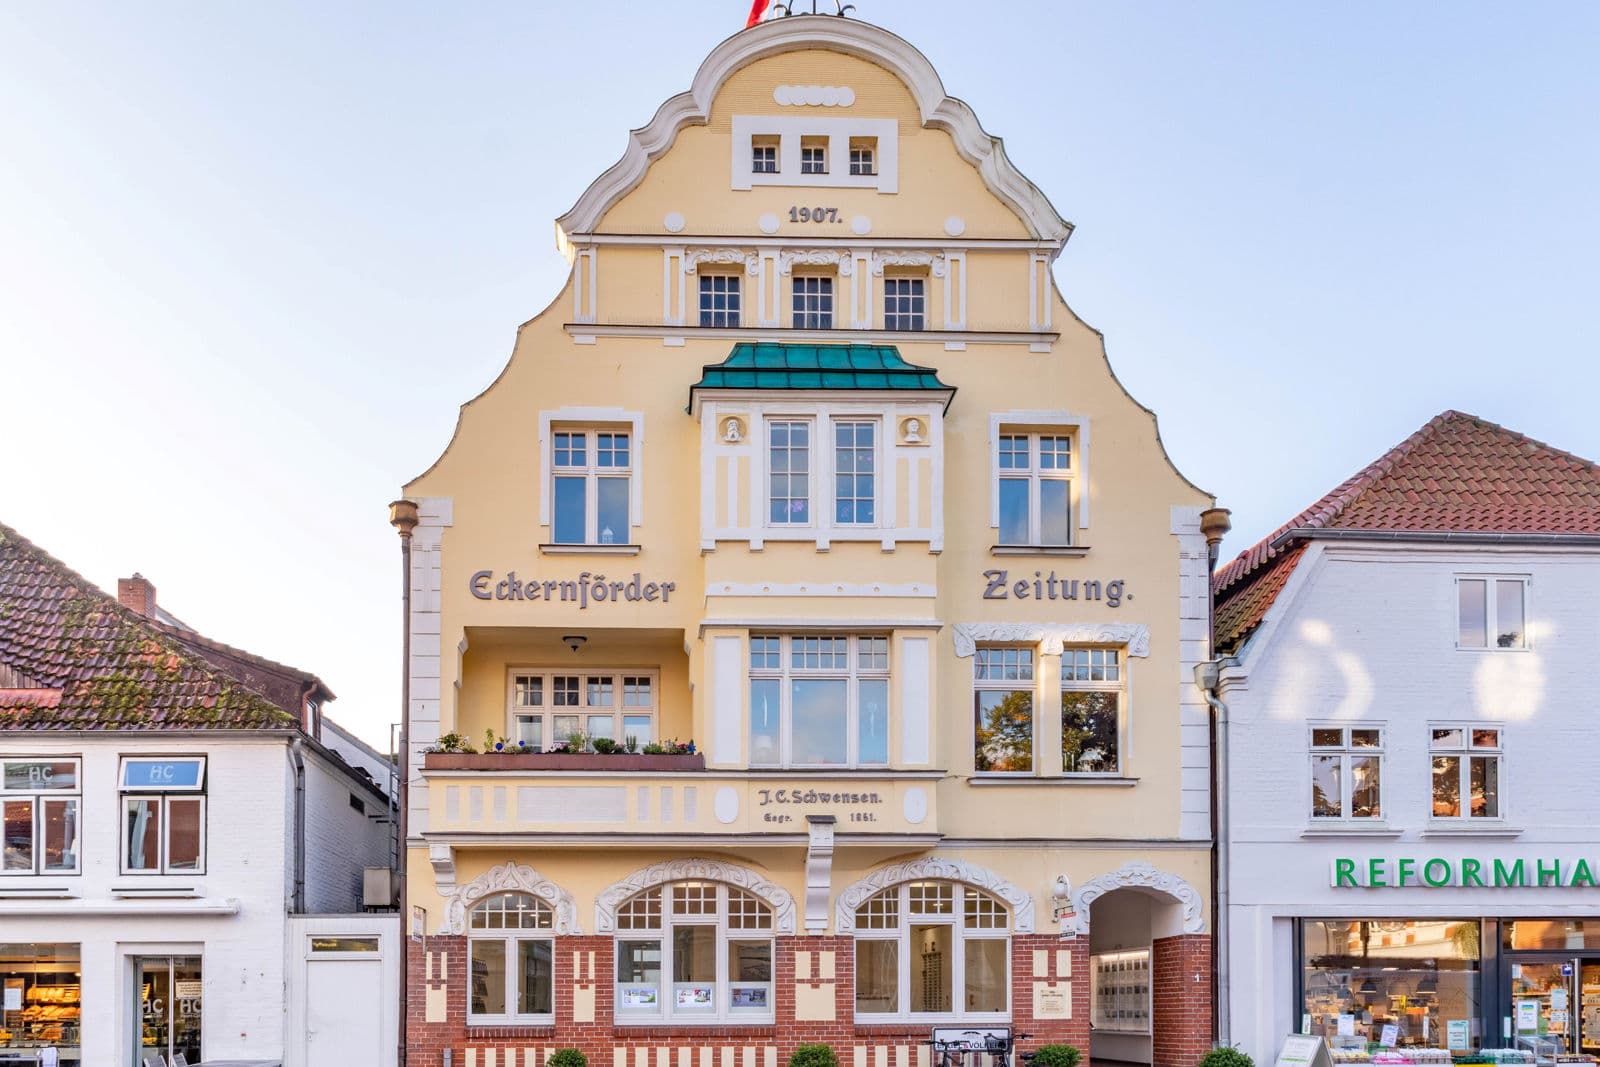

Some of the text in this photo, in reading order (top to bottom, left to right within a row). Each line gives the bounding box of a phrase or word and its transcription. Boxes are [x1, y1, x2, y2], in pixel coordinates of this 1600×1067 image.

[789, 206, 843, 223] 1907.
[469, 570, 676, 609] Eckernförder
[983, 569, 1133, 608] Zeitung.
[1335, 858, 1596, 887] REFORMHA
